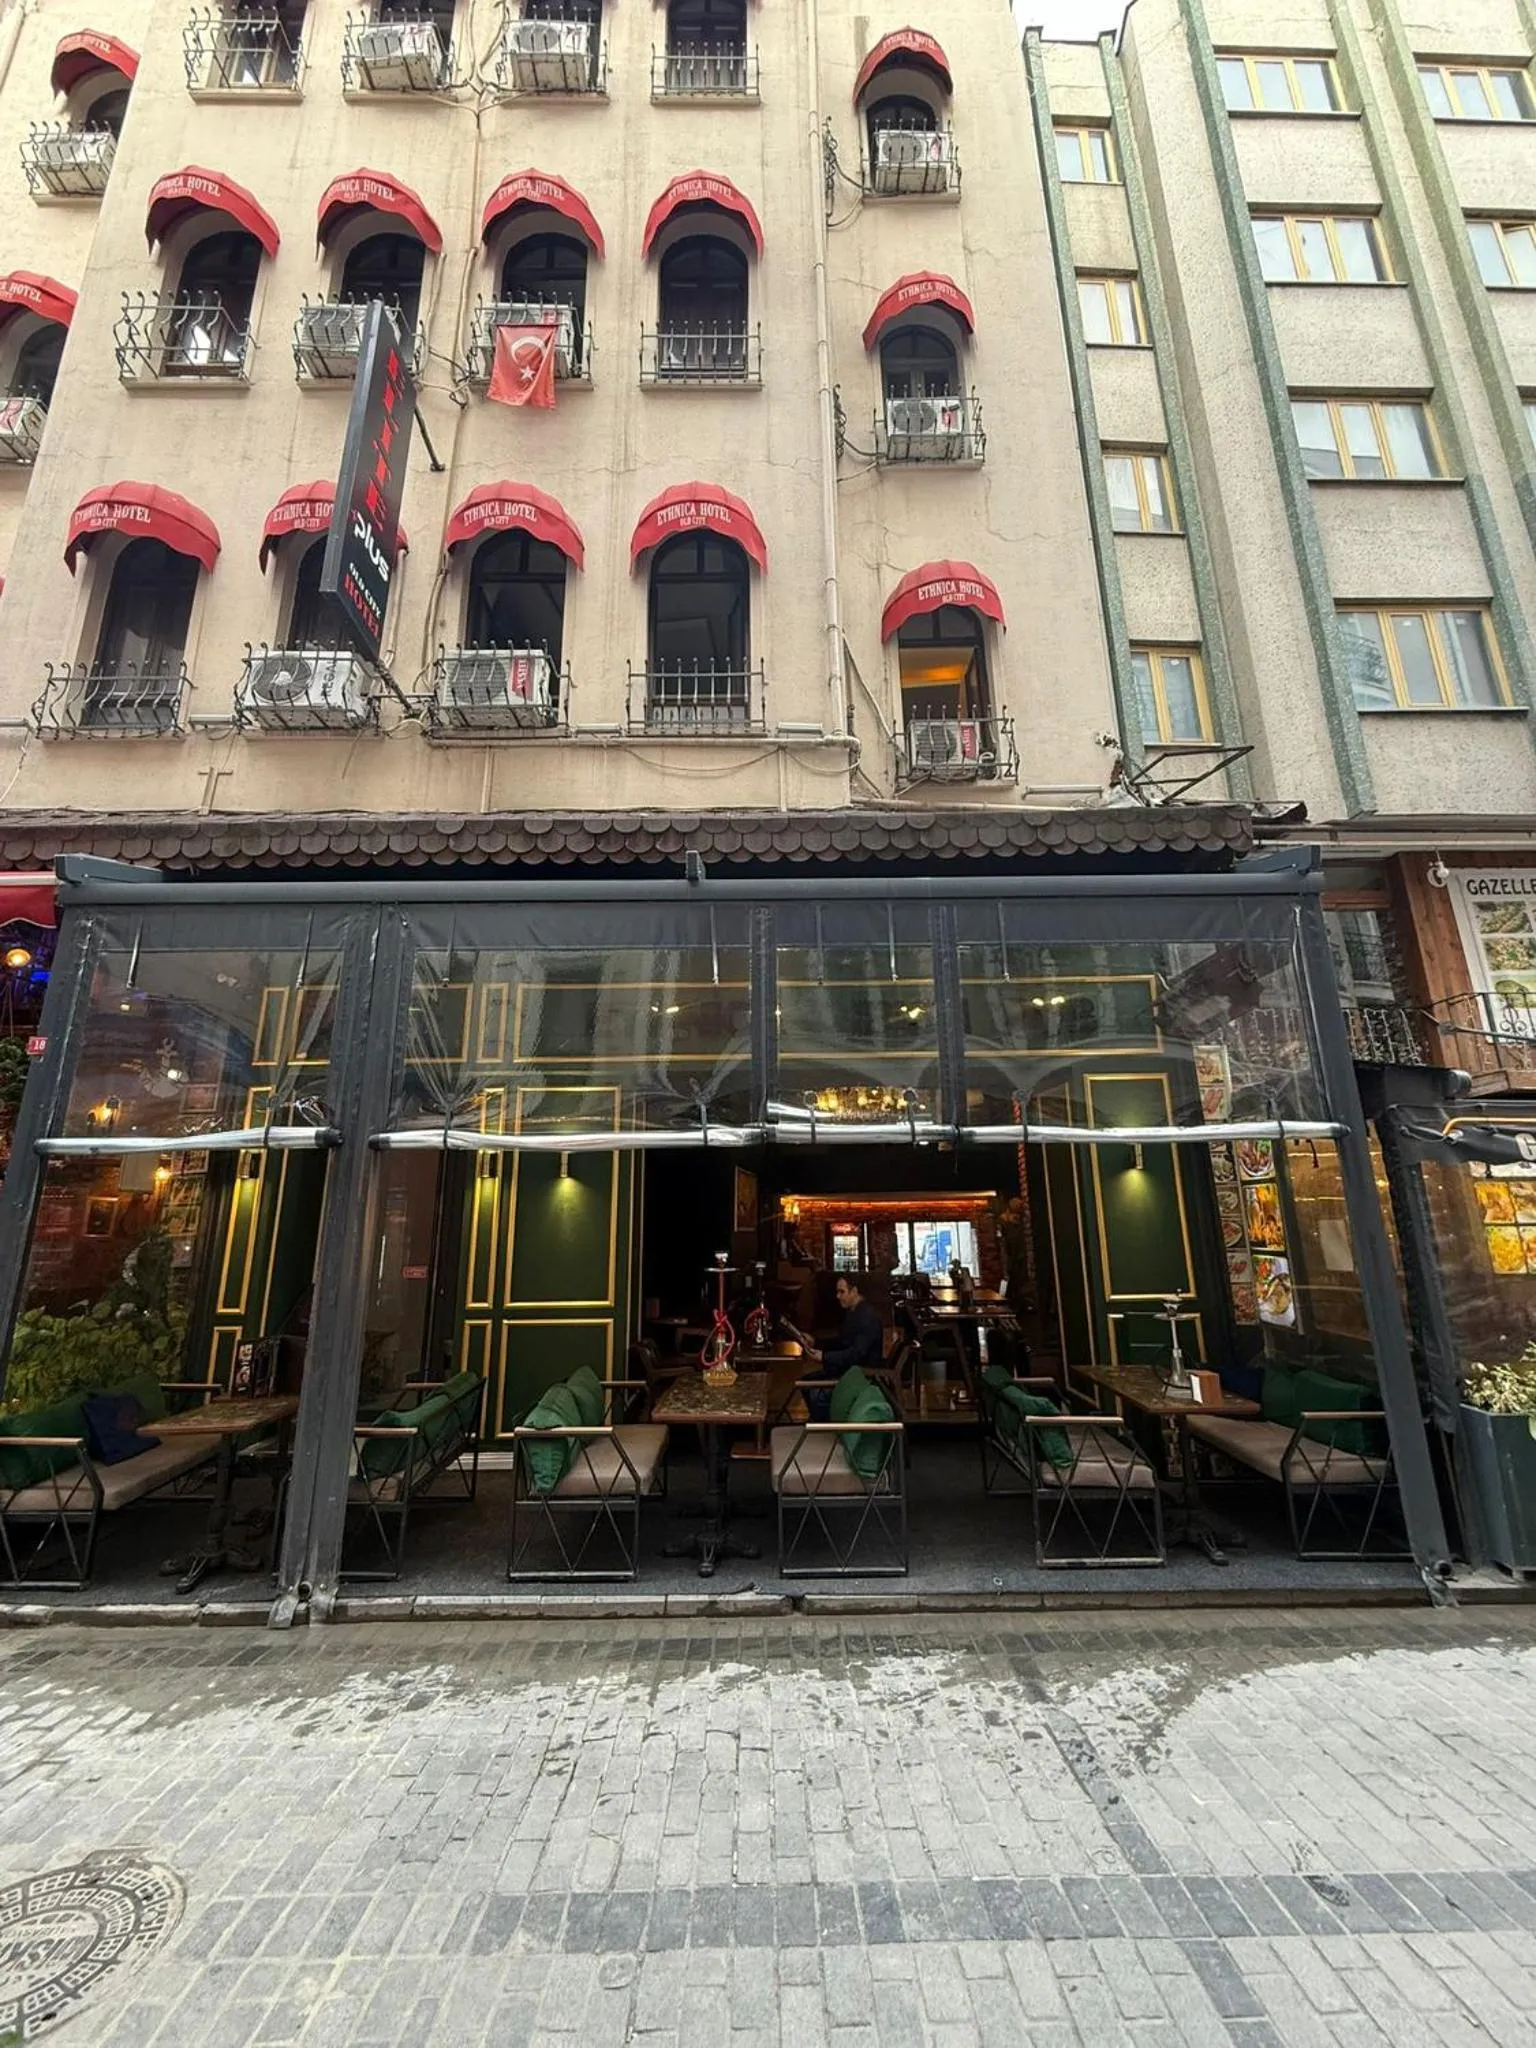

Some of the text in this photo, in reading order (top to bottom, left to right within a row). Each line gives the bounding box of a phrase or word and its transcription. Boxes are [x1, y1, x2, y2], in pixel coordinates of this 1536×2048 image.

[187, 176, 220, 197] HOTEL
[364, 179, 395, 201] HOTEL
[9, 282, 42, 304] HOTEL
[113, 503, 151, 524] HOTEL
[273, 502, 311, 522] ETHNICA
[463, 501, 537, 527] ETHNICA HOTEL
[657, 502, 732, 526] ETHNICA HOTEL
[354, 511, 389, 582] plus
[918, 580, 985, 601] ETHNICA HOTEL
[364, 589, 381, 619] CITY
[1466, 878, 1536, 895] GAZELLE
